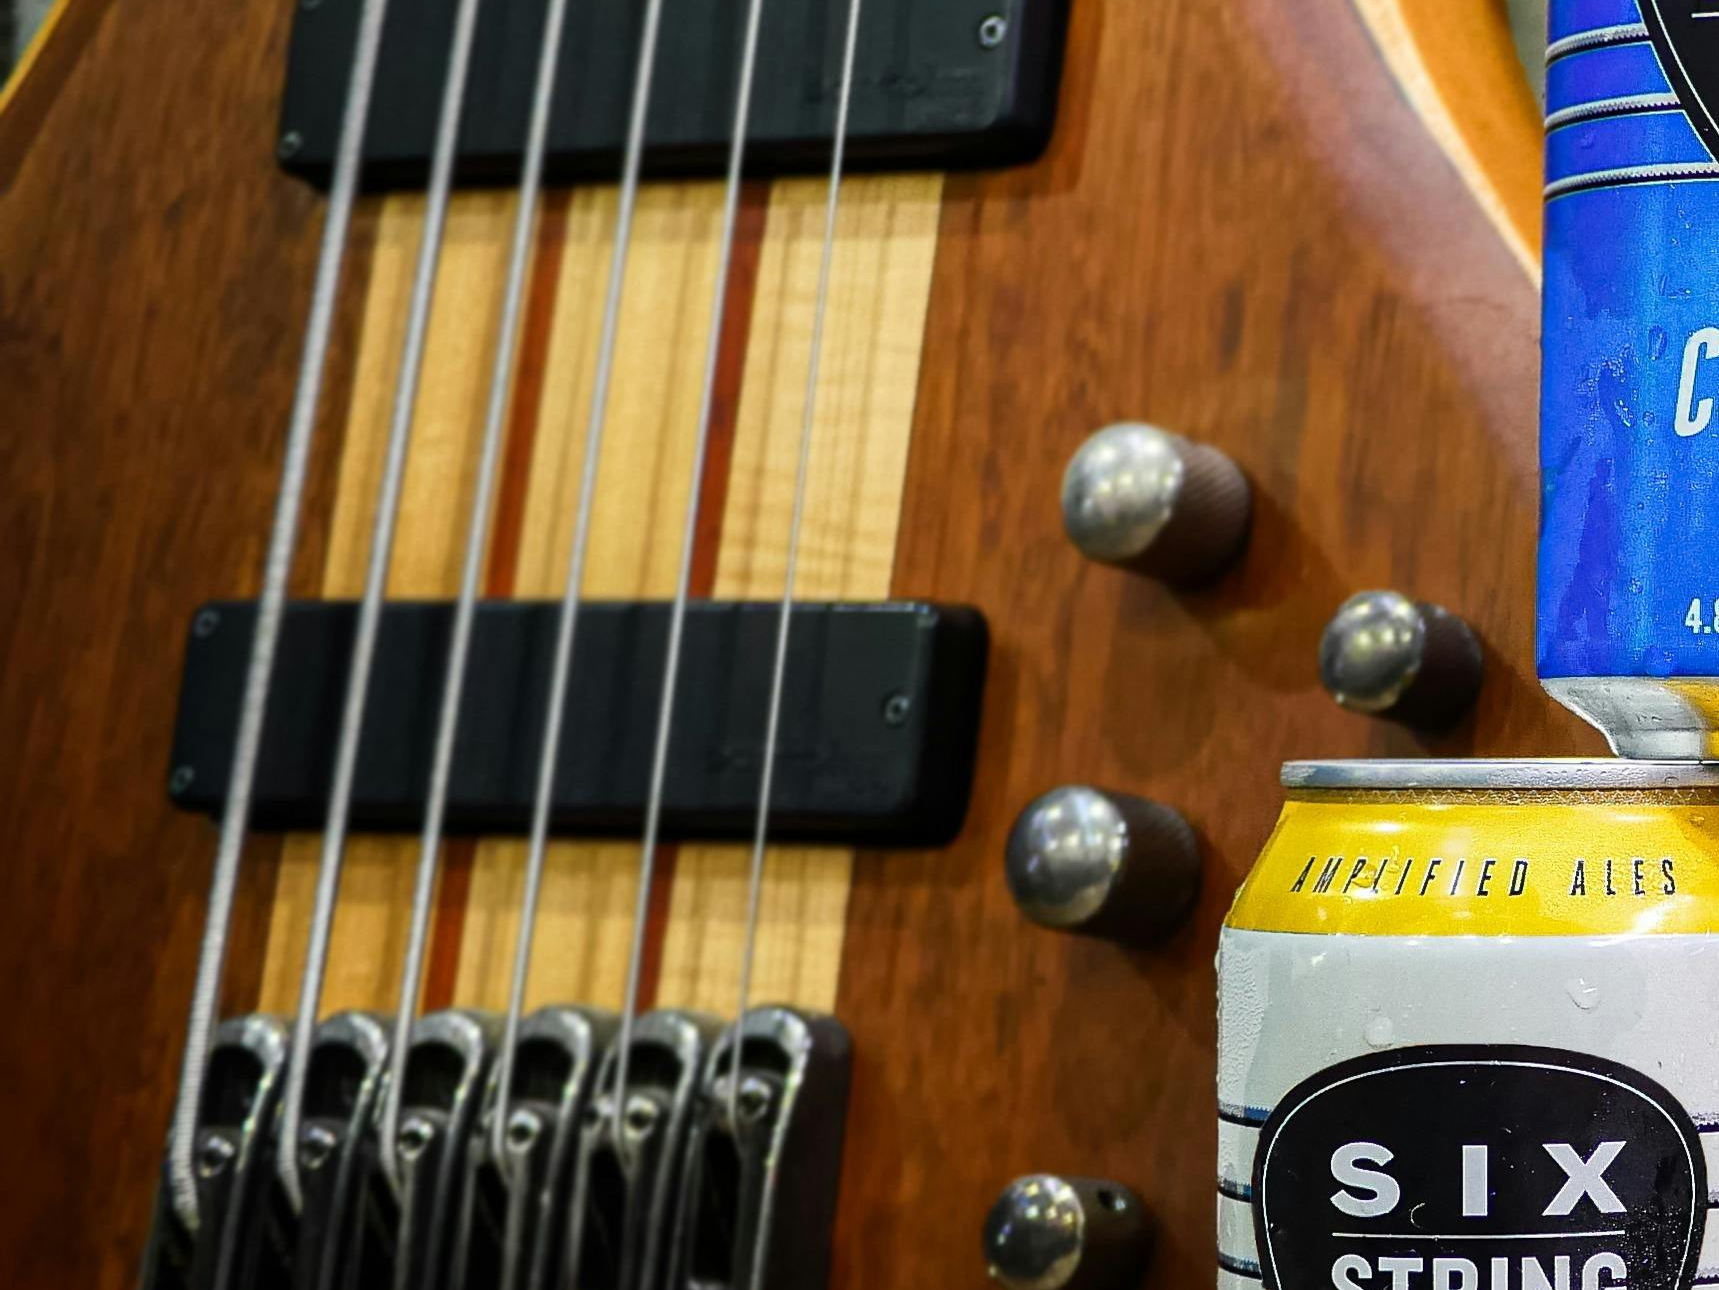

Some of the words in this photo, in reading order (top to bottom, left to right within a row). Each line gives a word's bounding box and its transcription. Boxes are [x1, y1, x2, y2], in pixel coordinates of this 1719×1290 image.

[1291, 856, 1527, 896] AMPLIFIED
[1571, 859, 1677, 897] ALES
[1329, 1140, 1627, 1218] SIX
